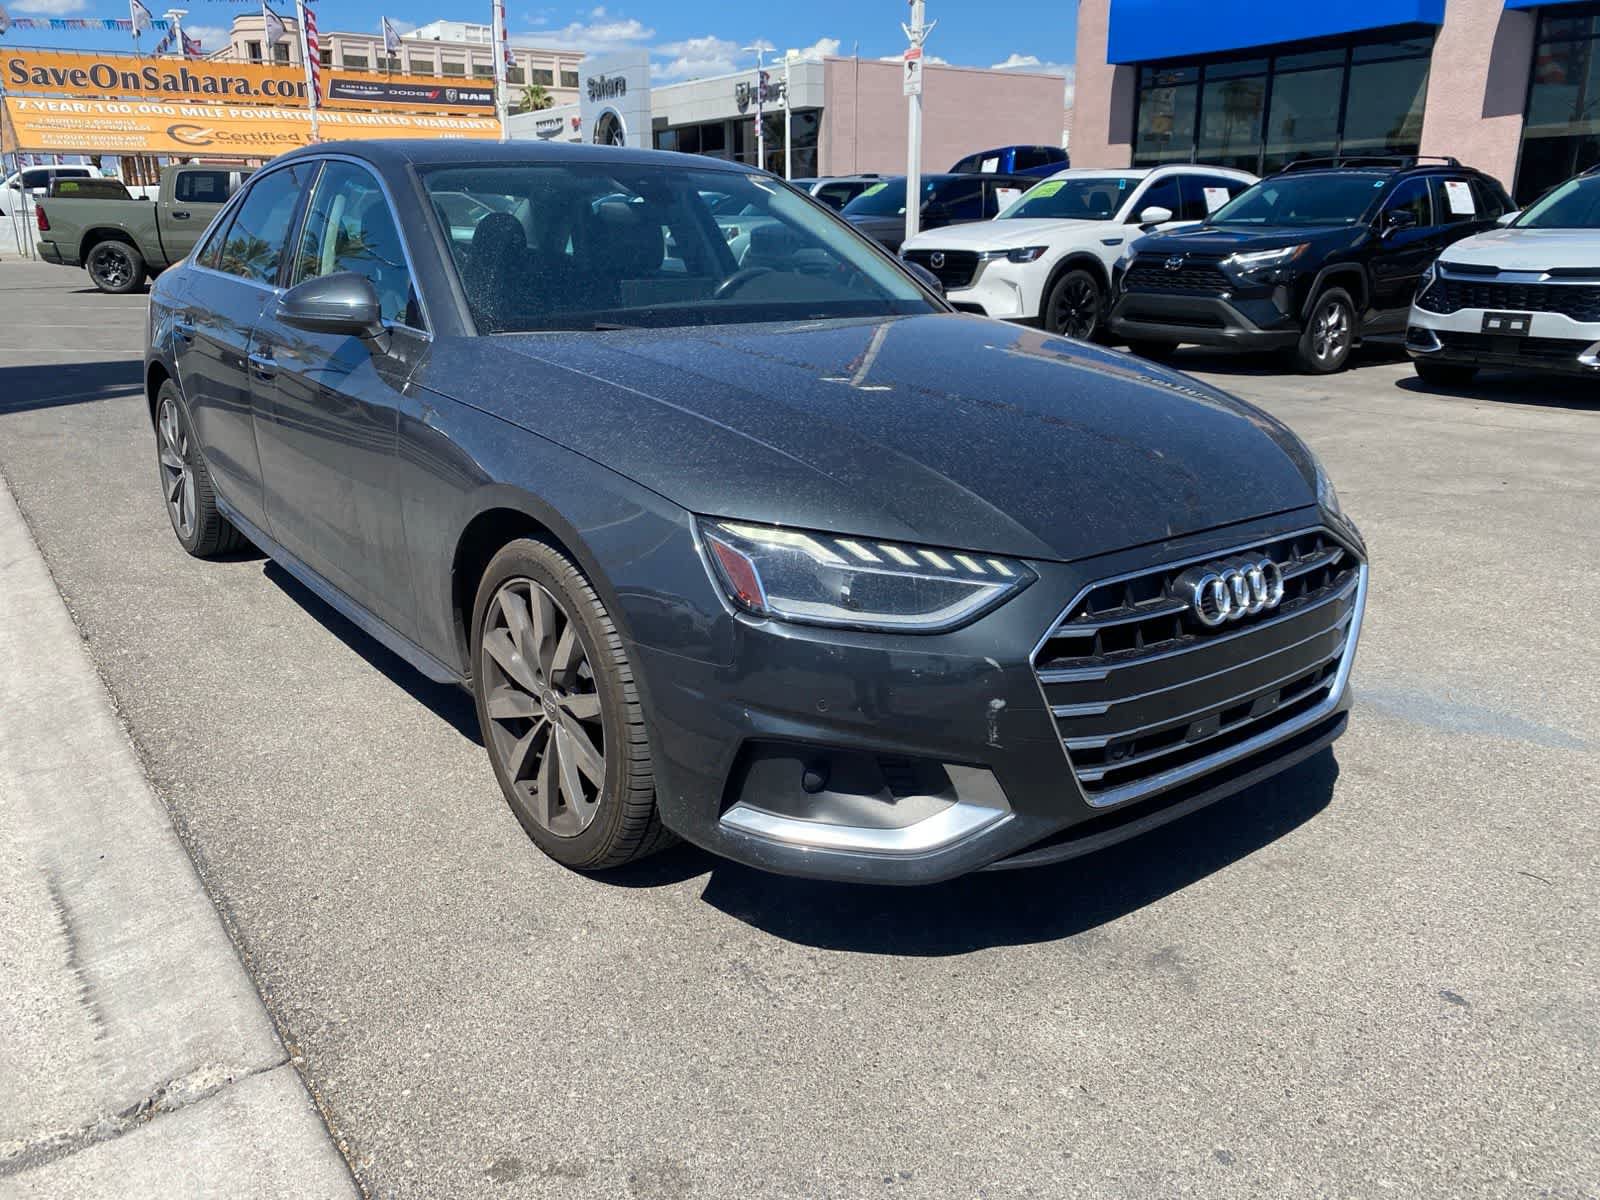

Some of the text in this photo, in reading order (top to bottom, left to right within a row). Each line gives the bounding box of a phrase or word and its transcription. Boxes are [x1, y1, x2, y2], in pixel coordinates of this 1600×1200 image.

[181, 106, 225, 118] MILE
[229, 108, 342, 123] POWERTRAIN
[345, 113, 411, 126] LIMITED
[413, 117, 496, 129] WARRANTY
[215, 130, 300, 142] Certified
